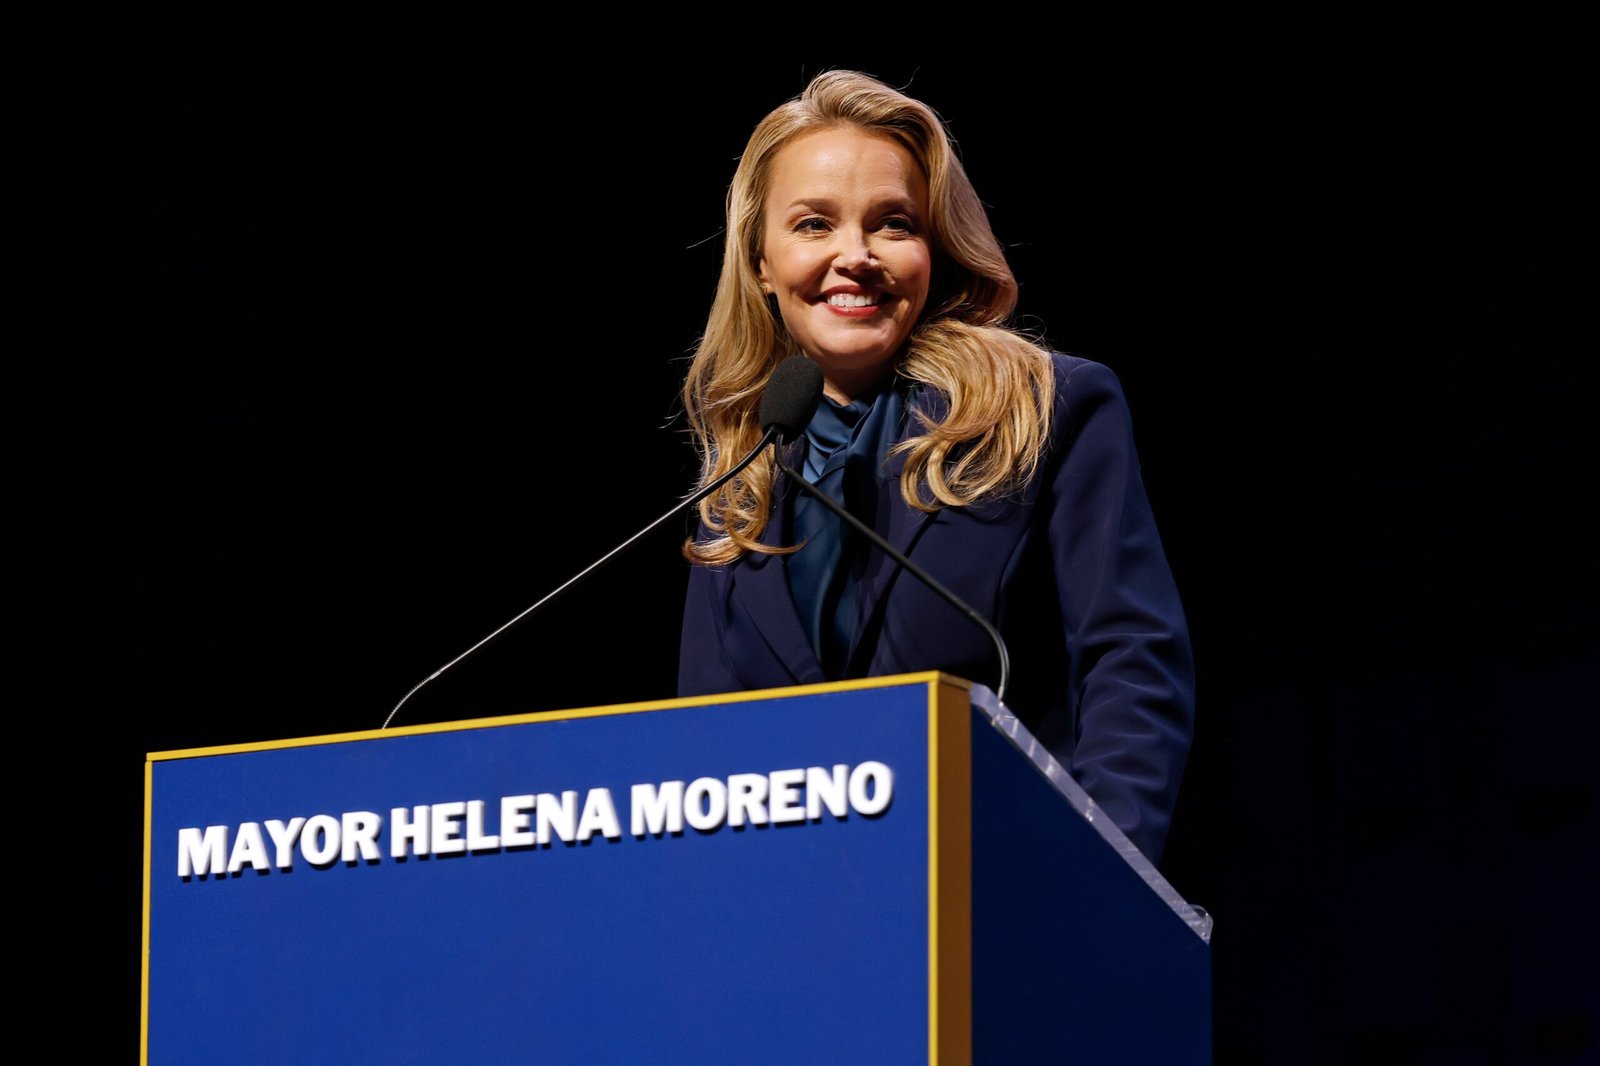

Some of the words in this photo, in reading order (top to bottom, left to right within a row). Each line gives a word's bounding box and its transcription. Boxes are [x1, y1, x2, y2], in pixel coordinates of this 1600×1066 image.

[177, 811, 382, 877] MAYOR
[390, 787, 622, 858] HELENA
[630, 761, 894, 836] MORENO
